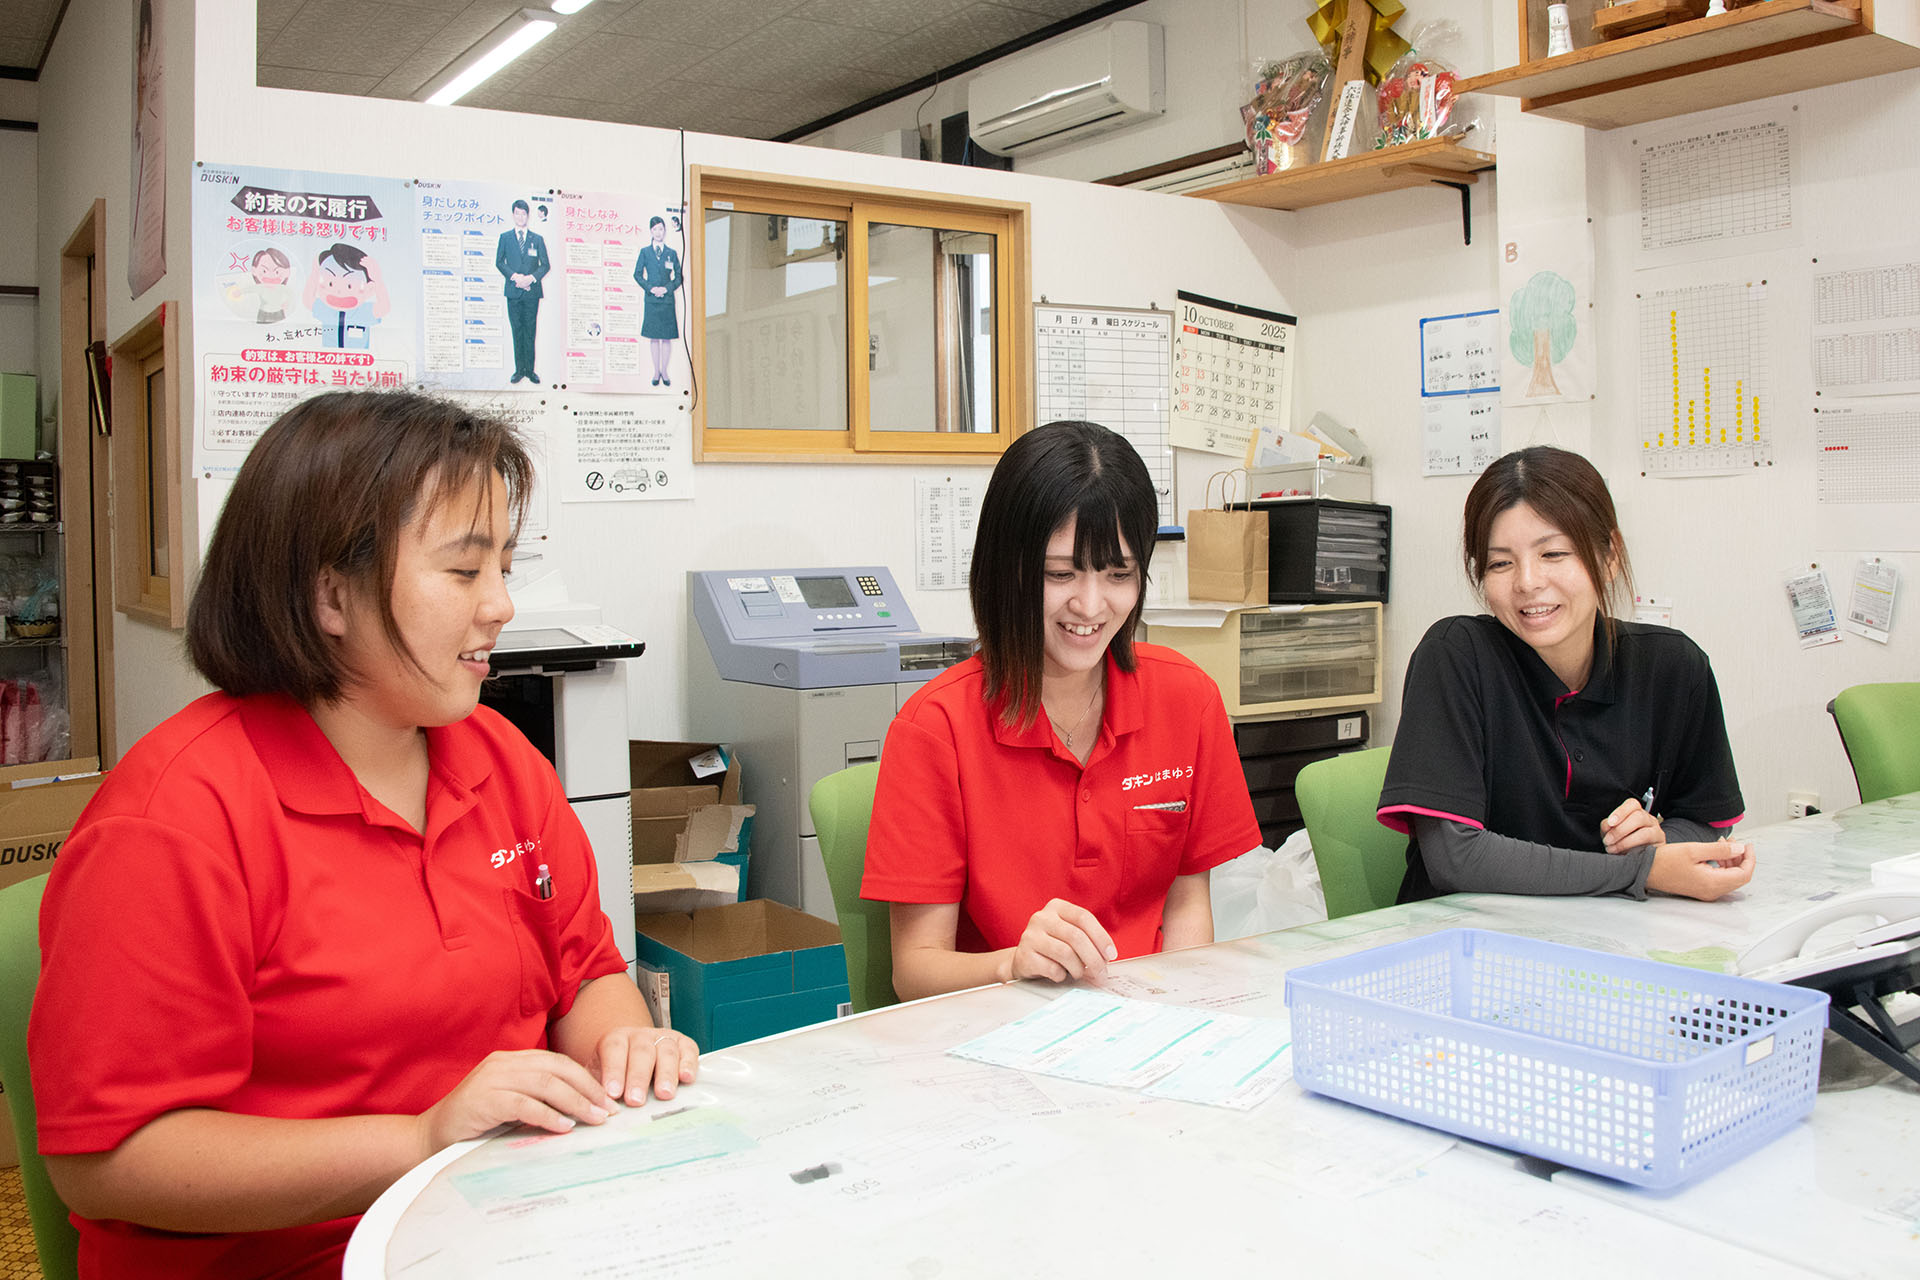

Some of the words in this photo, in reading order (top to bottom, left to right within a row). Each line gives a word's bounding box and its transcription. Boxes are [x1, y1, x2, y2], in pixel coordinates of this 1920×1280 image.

[200, 173, 240, 185] DUSKIN
[244, 191, 368, 220] 約束の不履行
[422, 195, 480, 209] 身だしなみ
[423, 211, 505, 225] チェックポイント
[565, 206, 619, 220] 身だしなみ
[566, 221, 643, 235] チェックポイント
[1504, 242, 1518, 263] B
[1055, 315, 1062, 324] 月
[1121, 318, 1160, 329] スケジュール
[1183, 305, 1198, 323] 10
[1199, 315, 1234, 331] OCTOBER
[1261, 323, 1287, 339] 2025
[1240, 344, 1245, 354] 2
[1254, 348, 1259, 357] 3
[1268, 351, 1274, 360] 4
[1183, 349, 1187, 359] 5
[1197, 352, 1202, 361] 6
[1212, 355, 1217, 364] 7
[1225, 358, 1230, 367] 8
[1238, 362, 1243, 371] 9
[1253, 365, 1260, 375] 10
[1268, 368, 1275, 377] 11
[1182, 366, 1190, 376] 12
[1197, 369, 1205, 379] 13
[1211, 372, 1219, 382] 14
[1224, 375, 1232, 385] 15
[1238, 378, 1245, 388] 16
[1252, 381, 1260, 391] 17
[1266, 384, 1274, 394] 18
[1181, 383, 1189, 393] 19
[1196, 386, 1205, 396] 20
[1210, 389, 1218, 399] 21
[1223, 392, 1232, 402] 22
[1236, 395, 1245, 405] 23
[1250, 398, 1259, 408] 24
[1265, 401, 1274, 411] 25
[1180, 400, 1189, 411] 26
[1195, 403, 1204, 413] 27
[1209, 406, 1218, 416] 28
[1222, 409, 1231, 419] 29
[1235, 412, 1244, 422] 30
[1249, 415, 1257, 424] 31
[0, 841, 65, 866] DUSK
